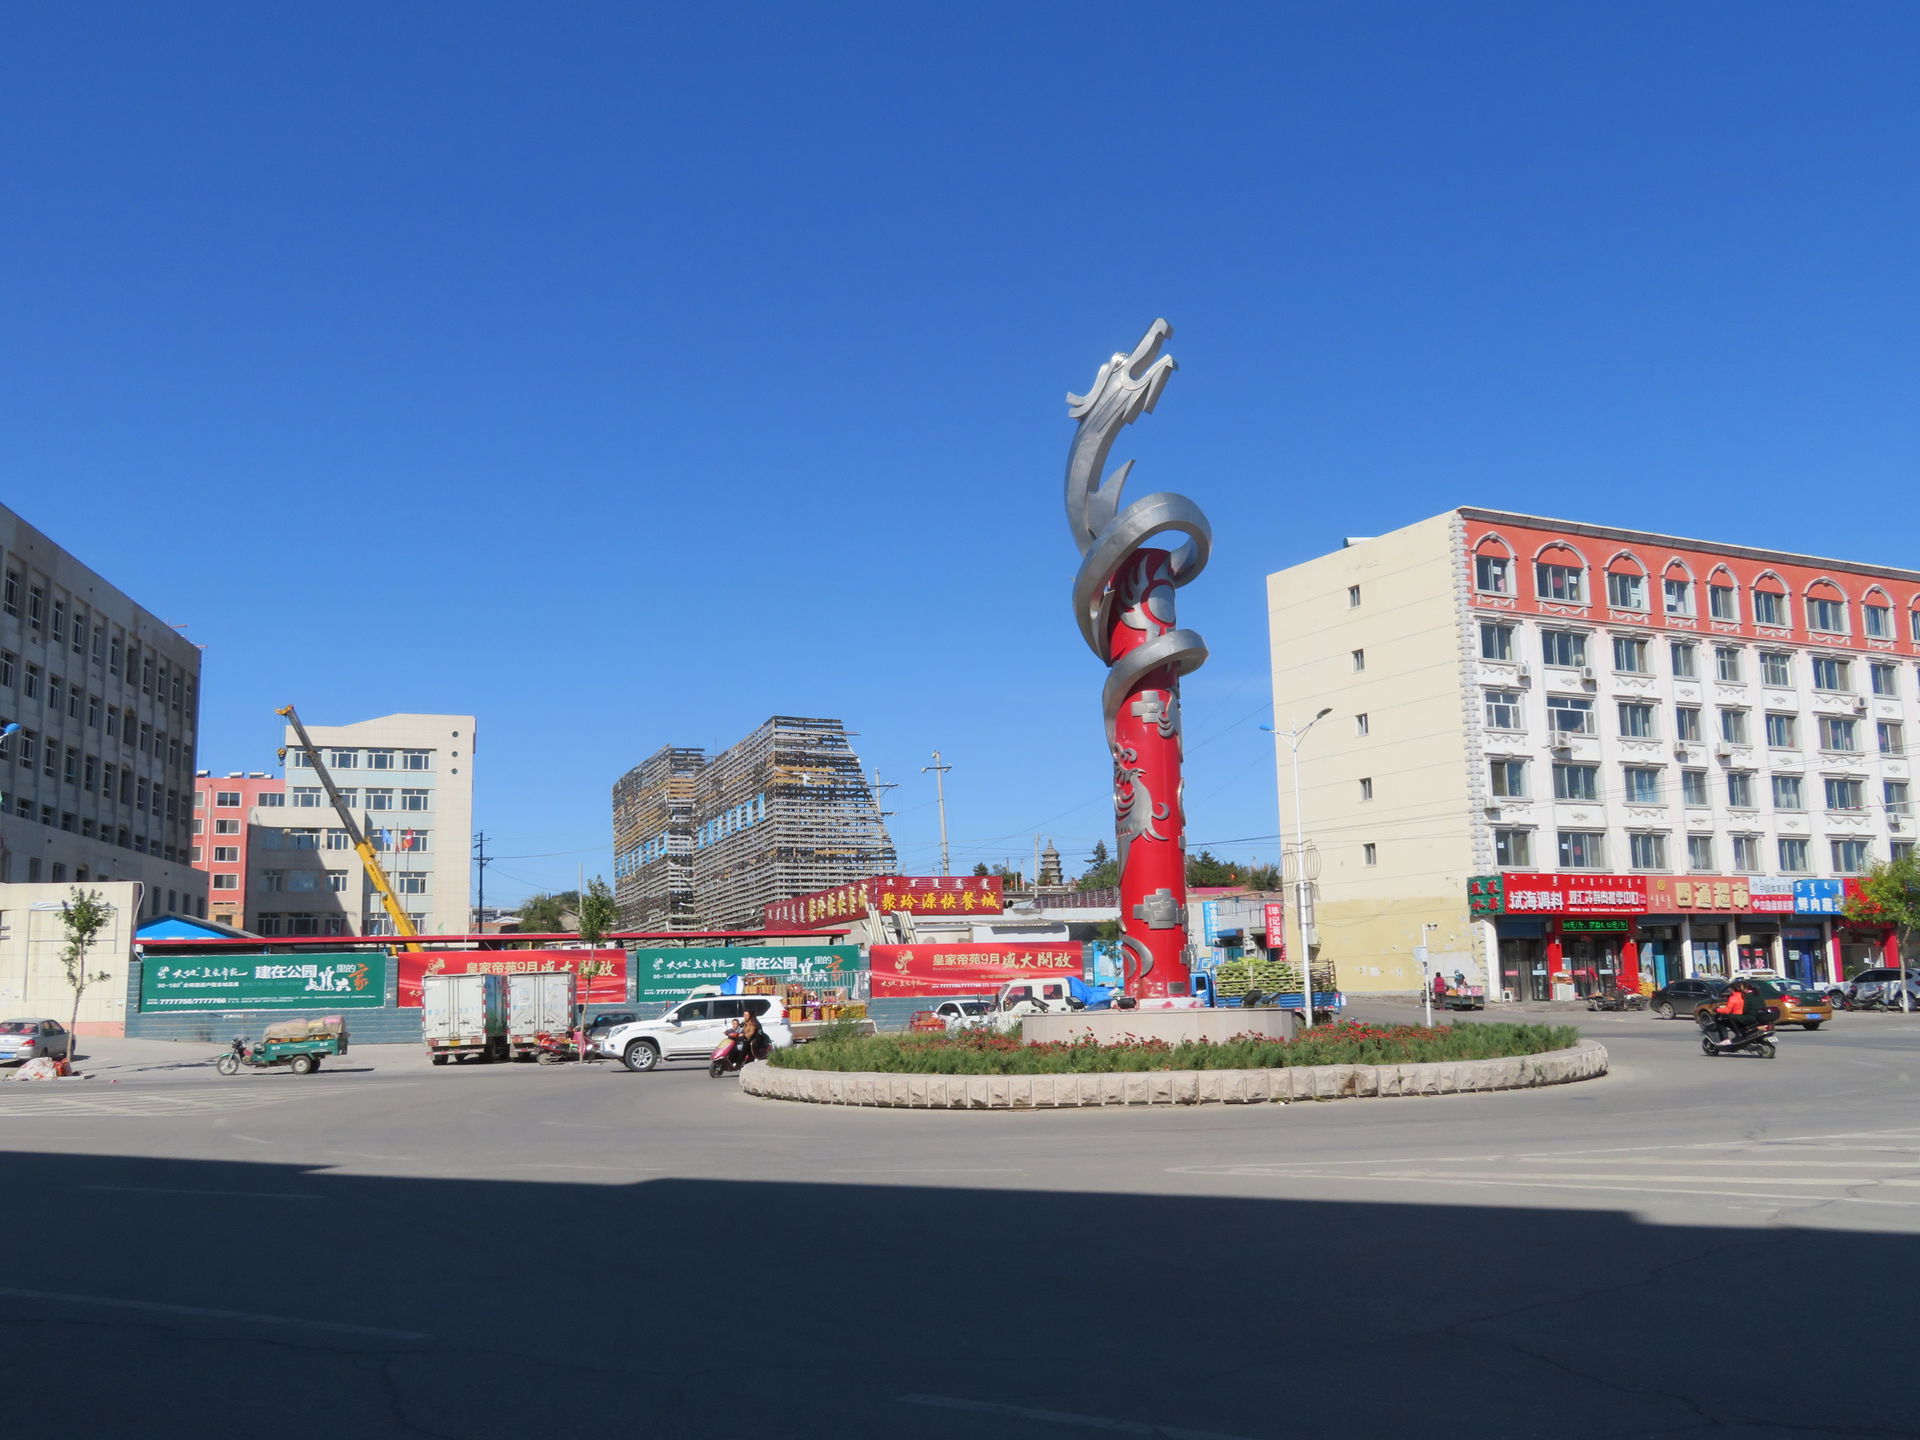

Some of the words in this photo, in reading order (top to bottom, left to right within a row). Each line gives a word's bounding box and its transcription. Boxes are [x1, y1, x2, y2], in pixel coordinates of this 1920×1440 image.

[881, 891, 1001, 911] 聚玲源快餐城
[1675, 881, 1750, 910] 四通超市
[255, 964, 317, 979] 建在公园
[742, 957, 798, 971] 建在公园
